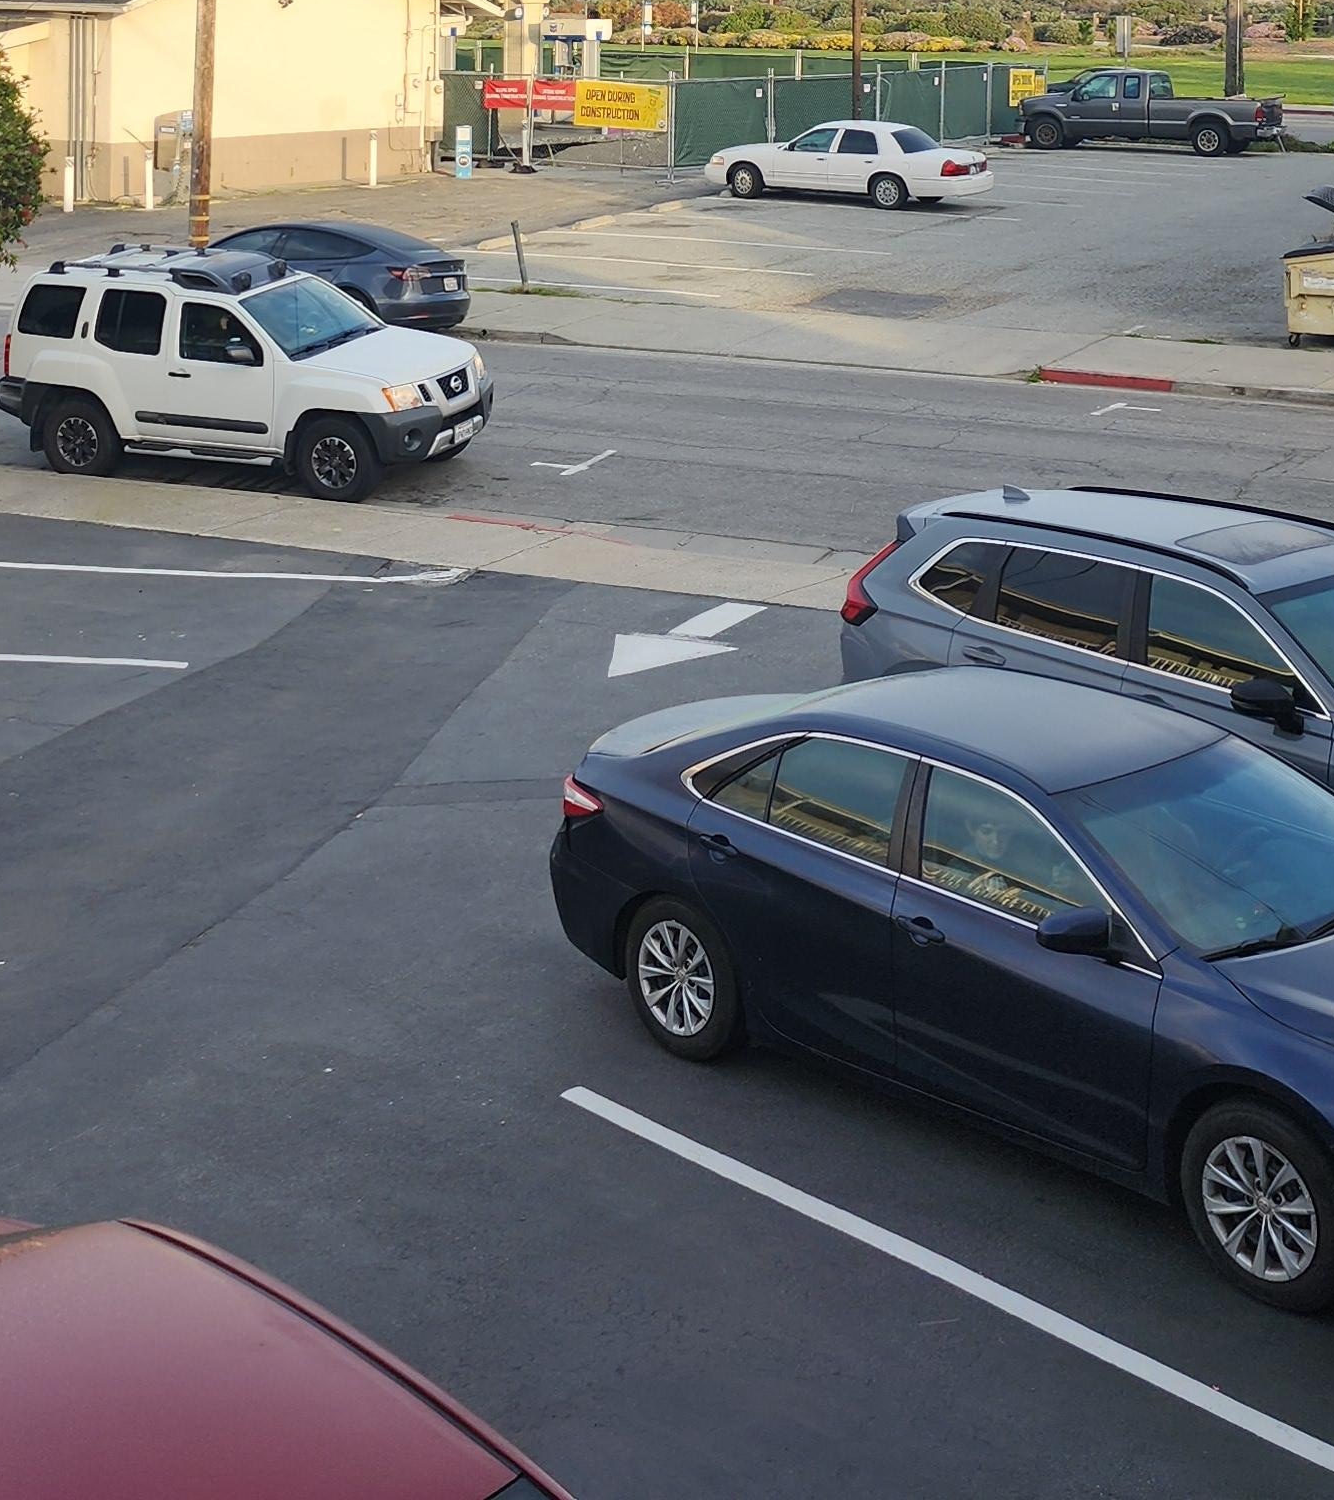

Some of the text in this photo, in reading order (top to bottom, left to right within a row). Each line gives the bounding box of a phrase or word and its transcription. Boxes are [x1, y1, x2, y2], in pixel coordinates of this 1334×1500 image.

[586, 89, 606, 102] OPEN
[607, 90, 636, 104] DURING
[580, 105, 640, 121] CONSTRUCTION
